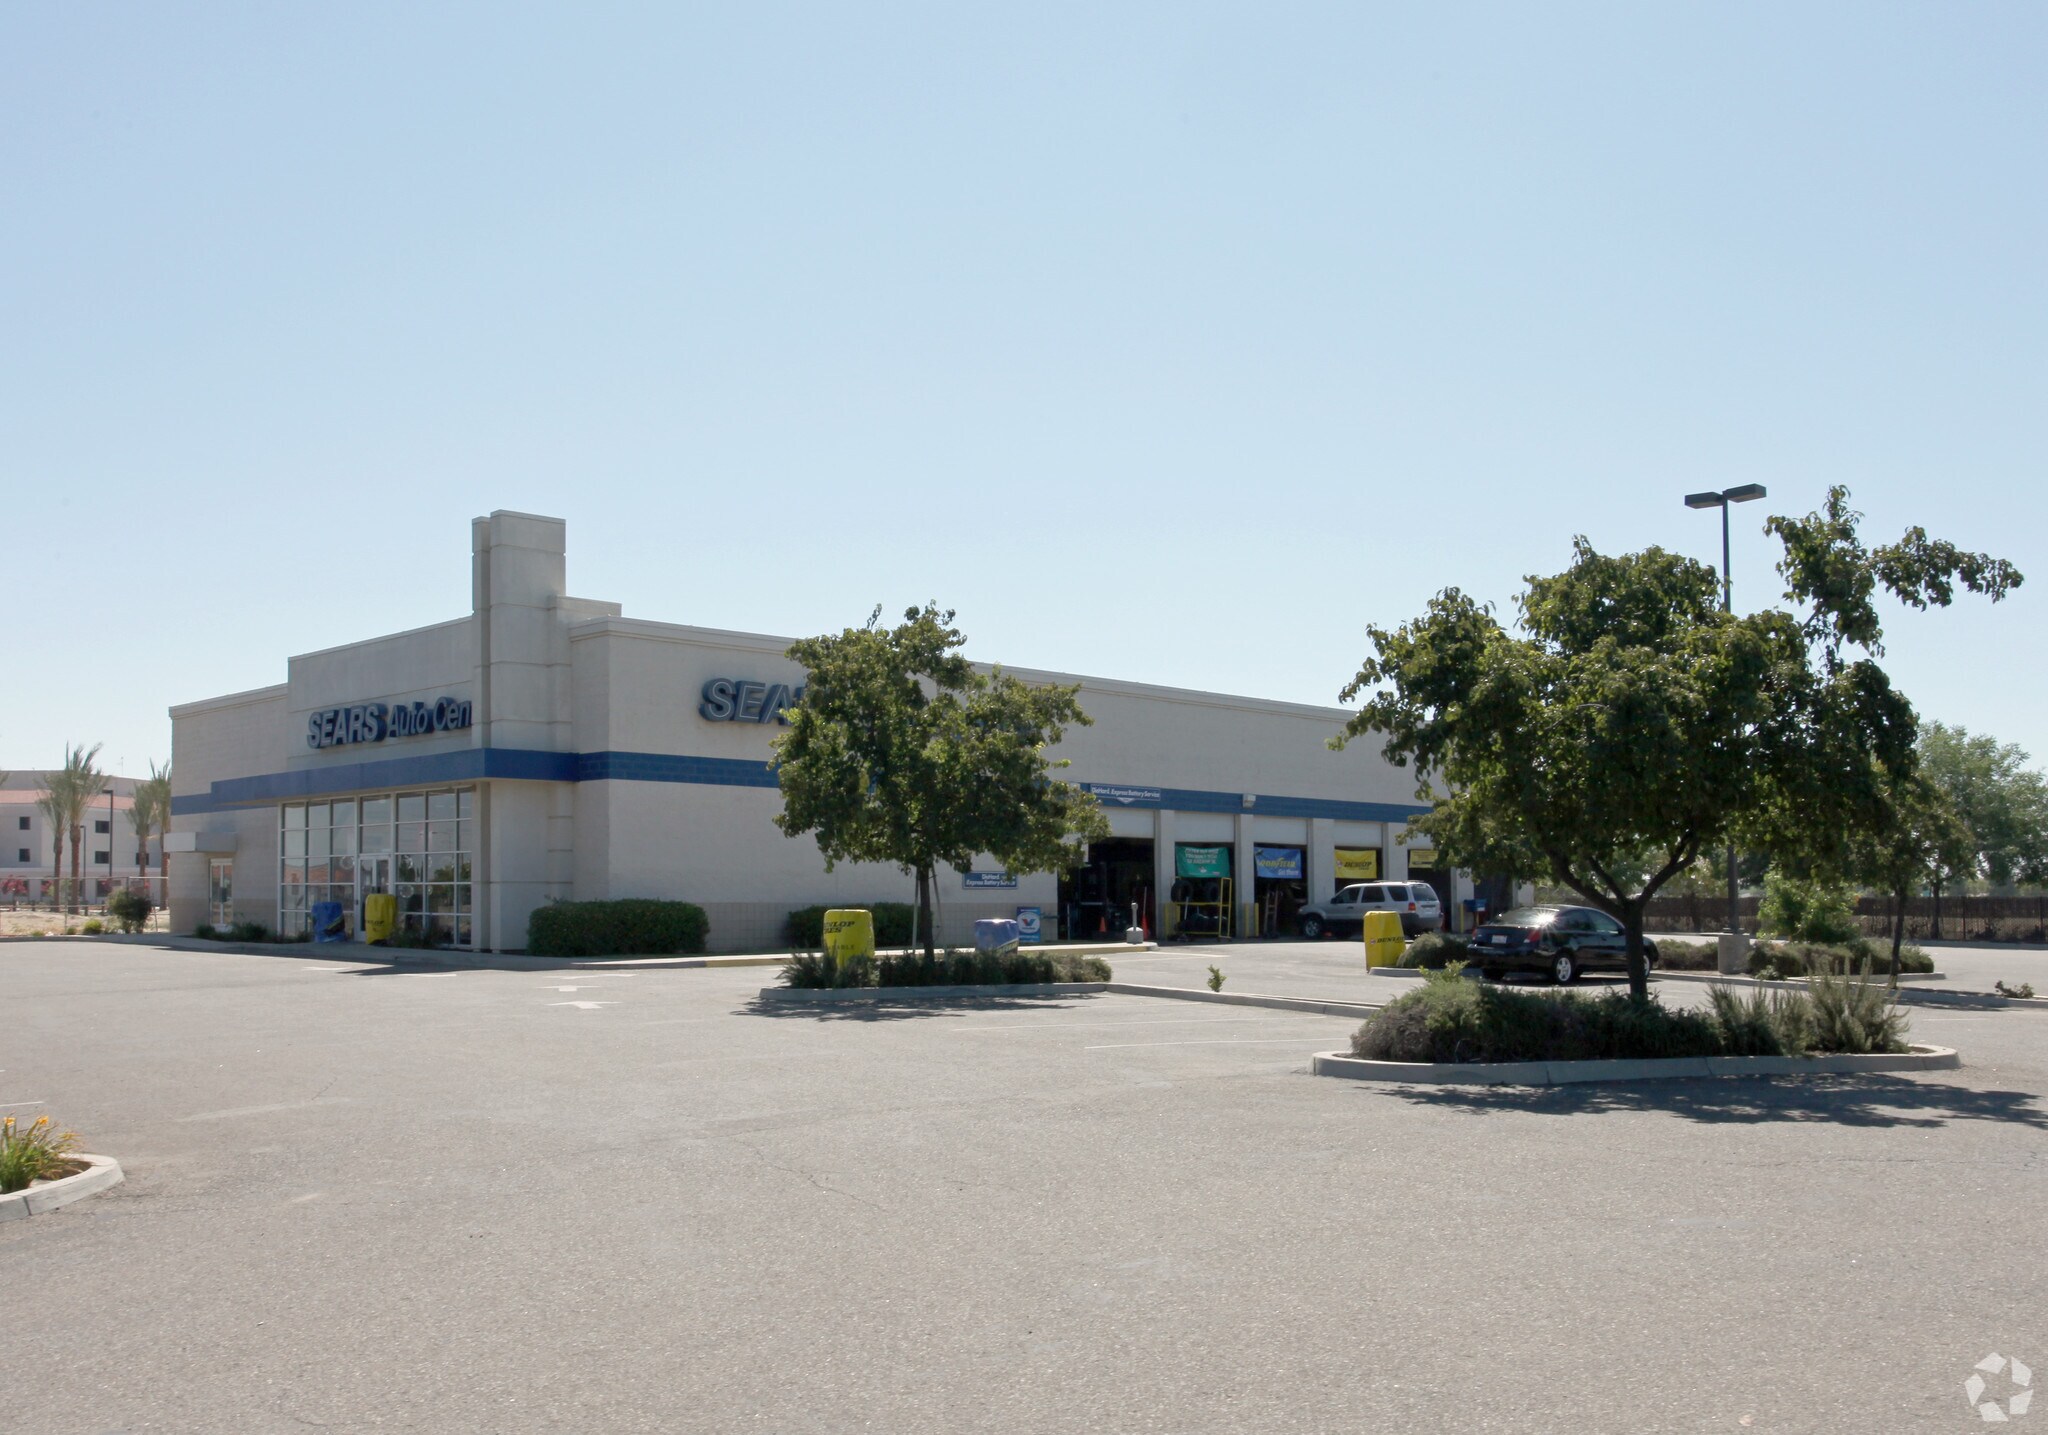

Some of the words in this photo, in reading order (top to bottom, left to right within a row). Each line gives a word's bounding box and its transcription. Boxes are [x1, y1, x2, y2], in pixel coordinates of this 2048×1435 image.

[699, 678, 807, 725] SEA
[307, 702, 388, 749] SEARS
[388, 701, 431, 737] Auto
[1111, 788, 1129, 797] Express
[1129, 789, 1144, 798] Battery
[1144, 790, 1160, 798] Service
[966, 879, 983, 887] Express
[984, 879, 1000, 887] Battery
